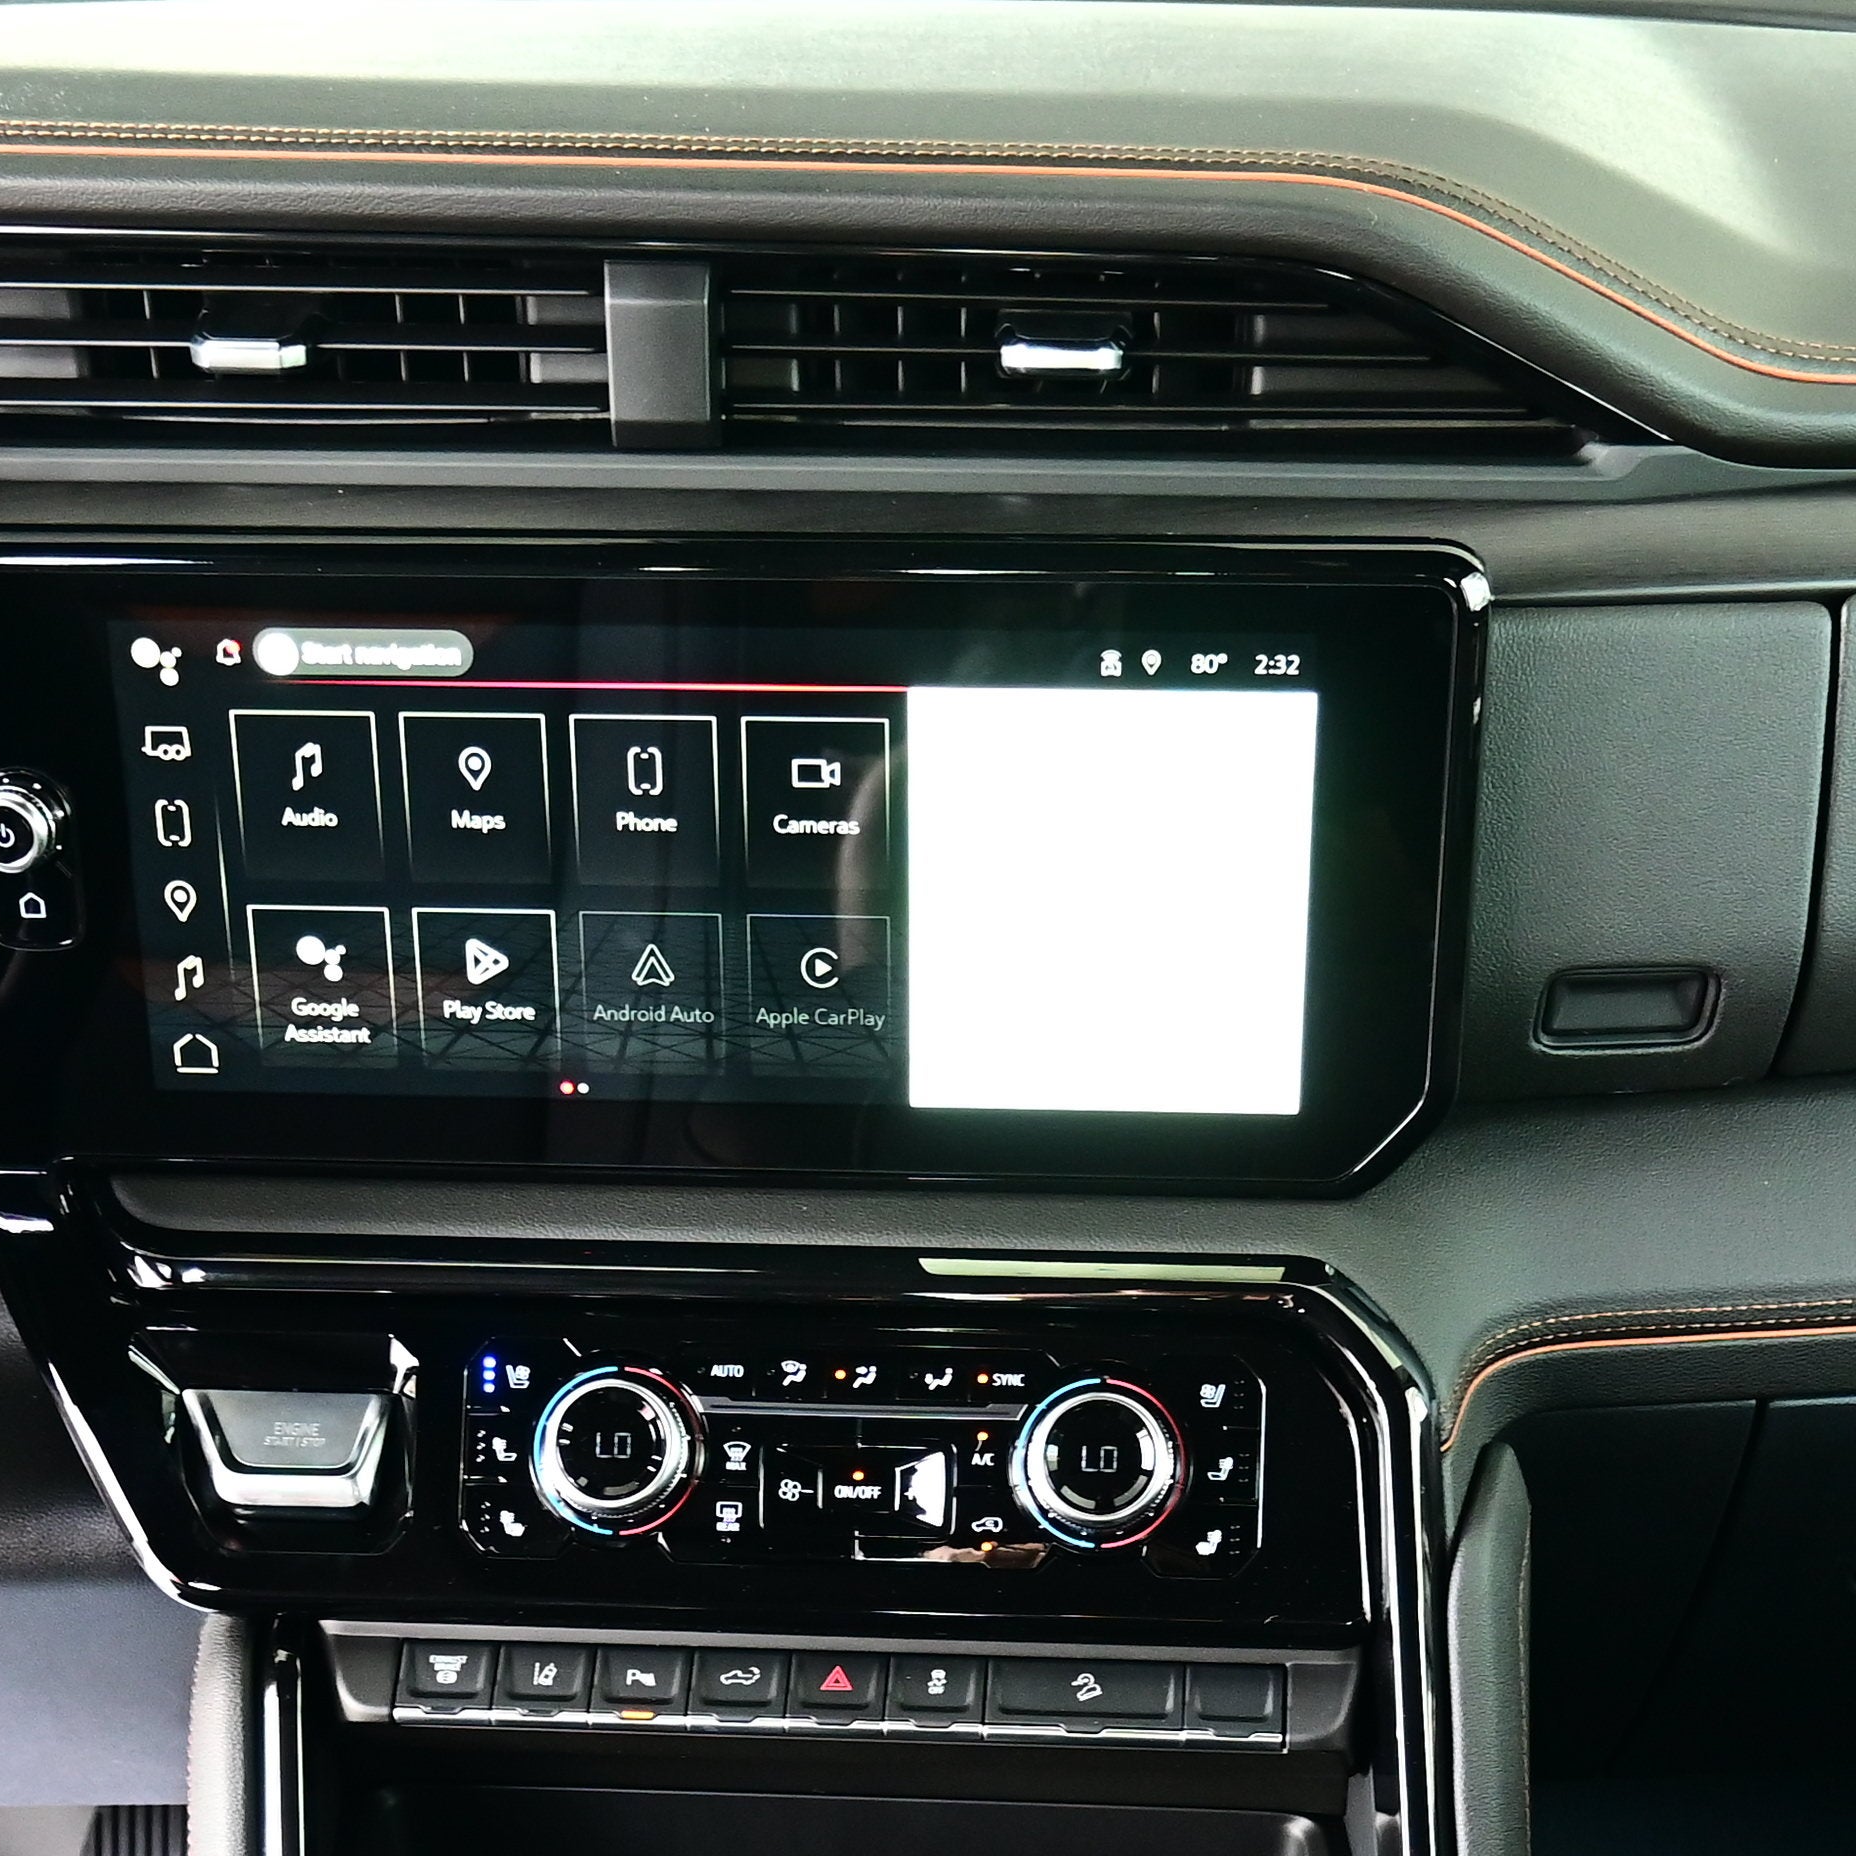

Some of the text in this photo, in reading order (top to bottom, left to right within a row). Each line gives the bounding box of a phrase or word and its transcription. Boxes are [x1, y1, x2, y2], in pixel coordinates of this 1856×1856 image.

[301, 641, 462, 671] Start navigation
[1254, 654, 1301, 676] 2:32
[281, 807, 338, 827] Audio
[451, 810, 506, 834] Maps
[616, 811, 678, 833] Phone
[772, 814, 861, 835] Cameras
[291, 997, 360, 1022] Google
[443, 999, 536, 1025] Play Store
[593, 1003, 715, 1024] Android Auto
[755, 1007, 886, 1032] Apple CarPlay
[284, 1024, 372, 1044] Assistant
[711, 1364, 744, 1377] AUTO
[992, 1373, 1025, 1387] SYNC
[274, 1422, 320, 1436] ENGINE
[596, 1432, 631, 1458] LO
[971, 1453, 994, 1466] A/C
[1081, 1446, 1118, 1472] LO
[834, 1486, 882, 1499] ON/OFF
